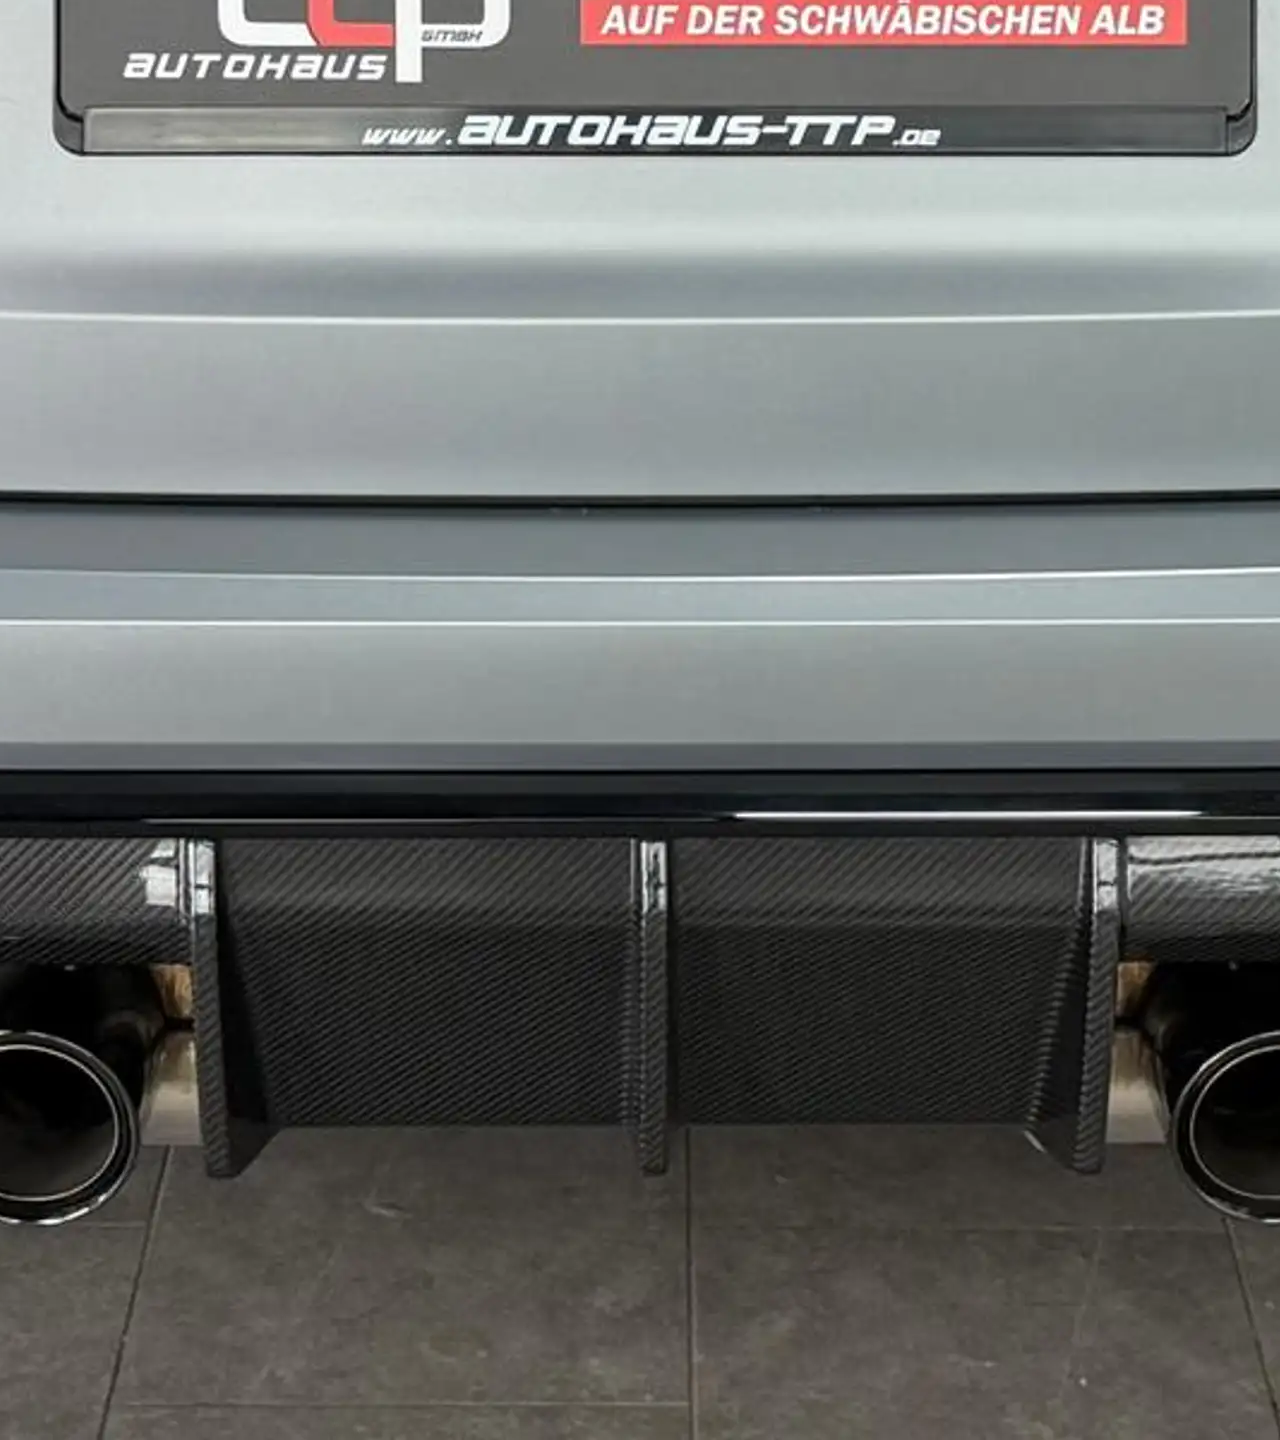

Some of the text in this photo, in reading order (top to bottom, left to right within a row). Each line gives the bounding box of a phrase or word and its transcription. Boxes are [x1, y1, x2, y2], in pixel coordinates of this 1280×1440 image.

[600, 4, 679, 36] AUF
[686, 4, 763, 36] DER
[1090, 4, 1166, 36] ALB
